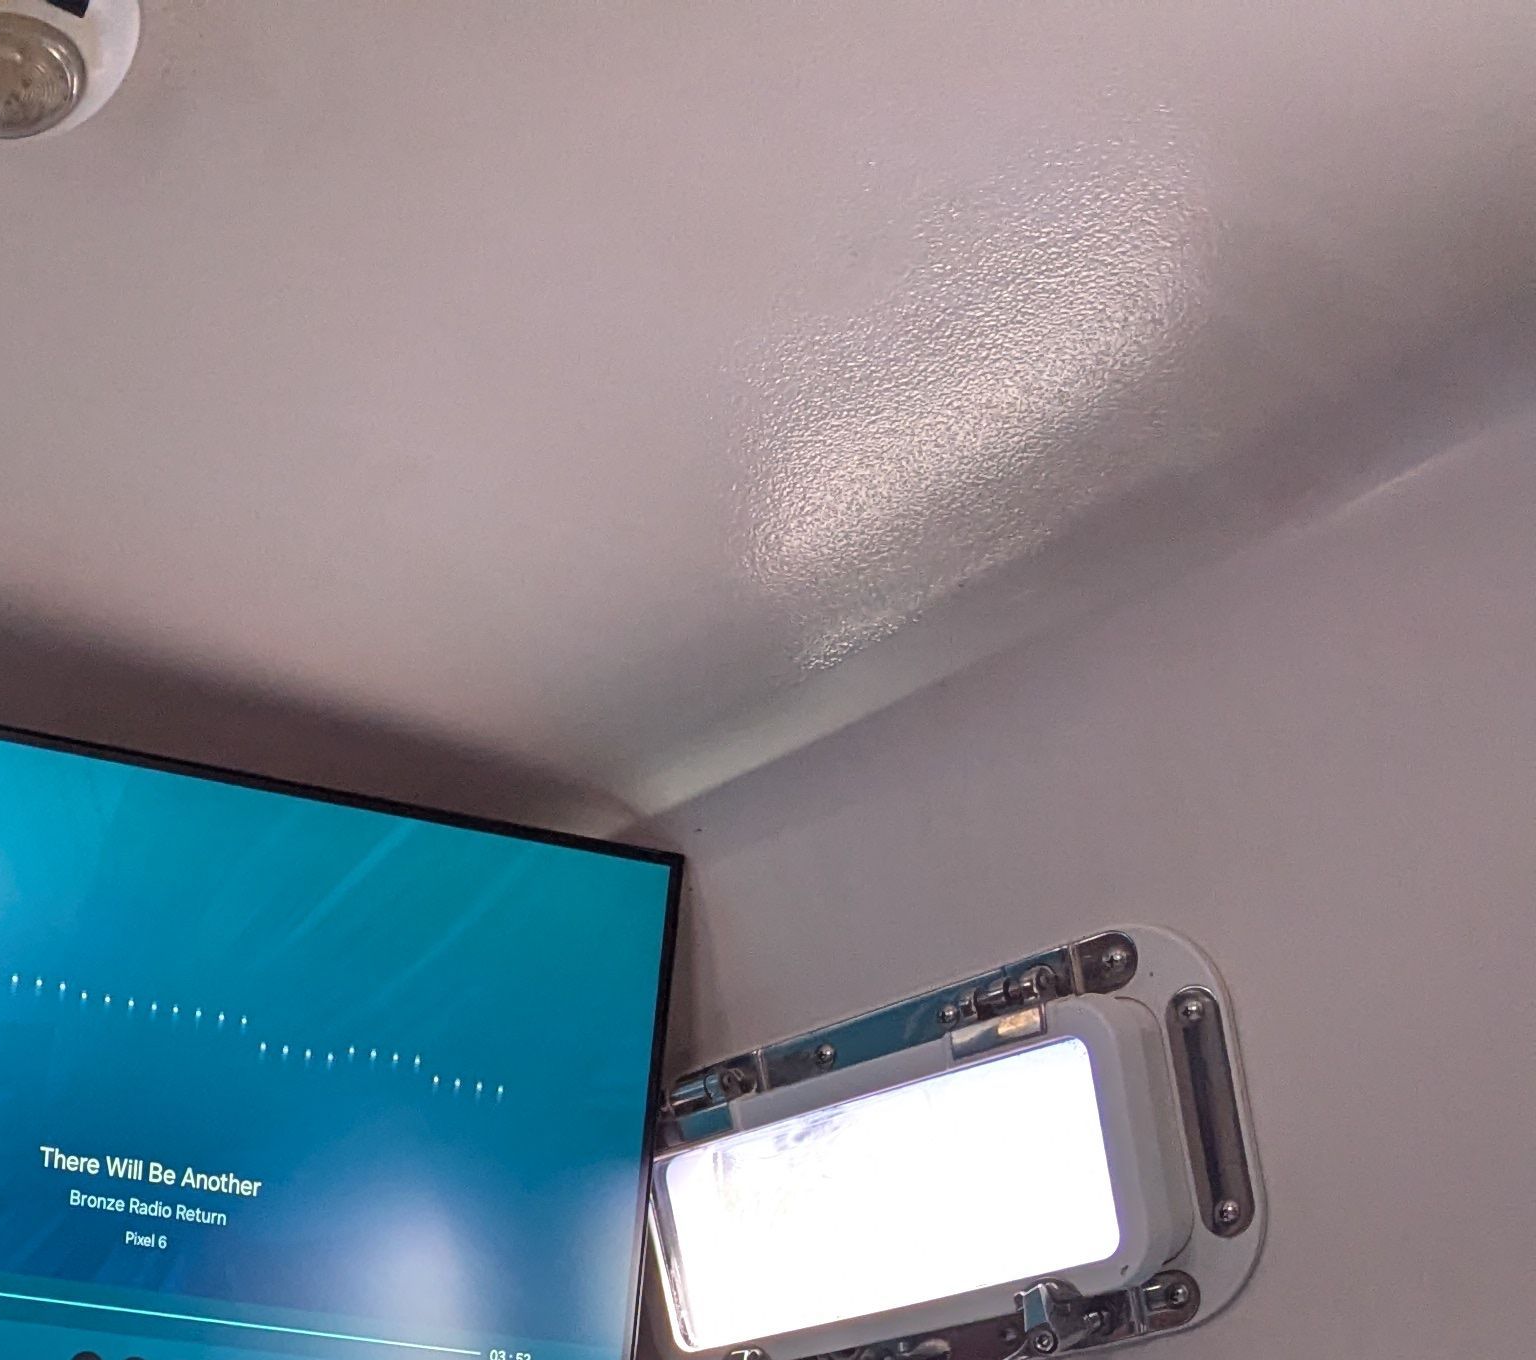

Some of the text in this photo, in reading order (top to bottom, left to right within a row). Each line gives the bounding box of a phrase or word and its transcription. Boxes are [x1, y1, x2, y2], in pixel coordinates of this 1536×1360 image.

[40, 1146, 262, 1197] There Will Be Another
[70, 1190, 227, 1226] Bronze Radio Return
[125, 1231, 168, 1249] Pixel 6
